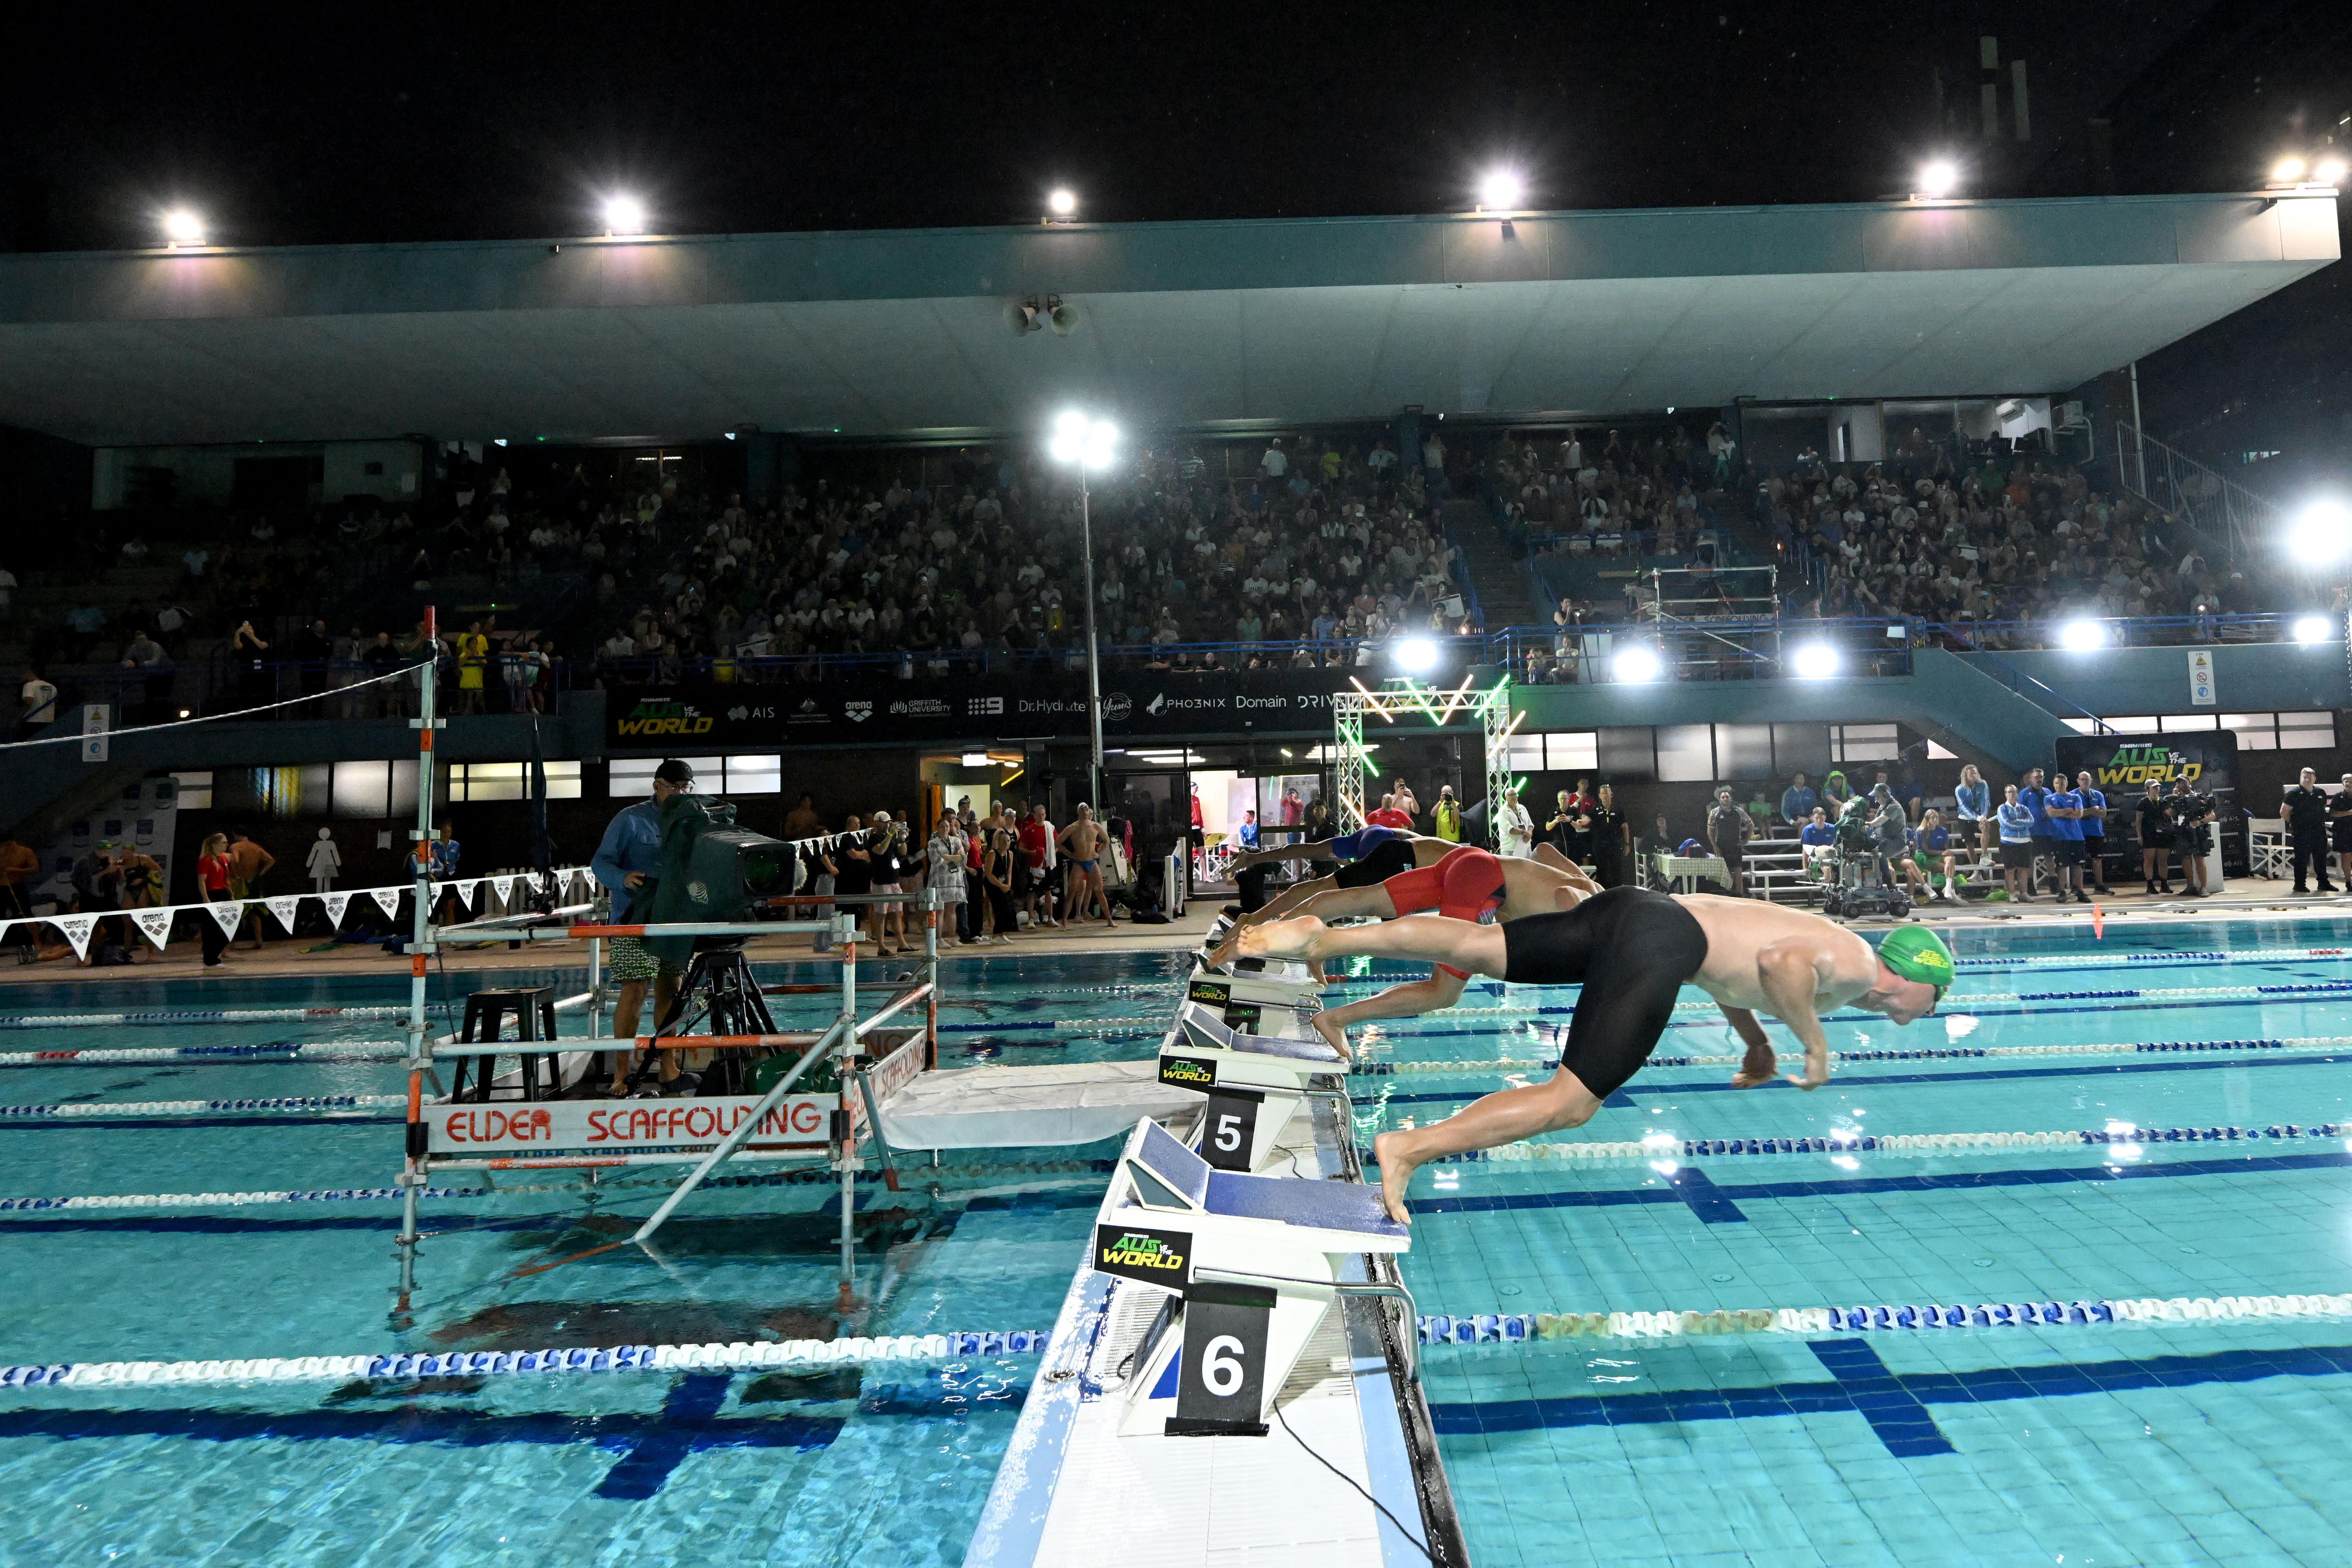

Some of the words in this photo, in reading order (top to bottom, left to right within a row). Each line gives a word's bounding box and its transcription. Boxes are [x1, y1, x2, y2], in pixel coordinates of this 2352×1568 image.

[846, 701, 871, 709] arena
[986, 697, 1003, 714] 9
[1236, 695, 1287, 708] Domain
[1298, 695, 1345, 708] DRIV
[629, 702, 684, 718] AUS
[753, 707, 774, 718] AIS
[618, 717, 713, 735] WORLD
[2108, 747, 2170, 767] AUS
[2098, 763, 2201, 785] WORLD
[64, 919, 88, 929] arena
[142, 913, 165, 923] arena
[1192, 991, 1227, 1001] WORLD
[882, 1038, 924, 1098] SCAFFOLDING
[1163, 1069, 1211, 1082] WORLD
[1168, 1062, 1199, 1073] AUS
[446, 1109, 551, 1142] ELDER
[1215, 1114, 1241, 1152] 5
[1112, 1236, 1162, 1253] AUS
[1104, 1248, 1184, 1270] WORLD
[1202, 1335, 1244, 1397] 6
